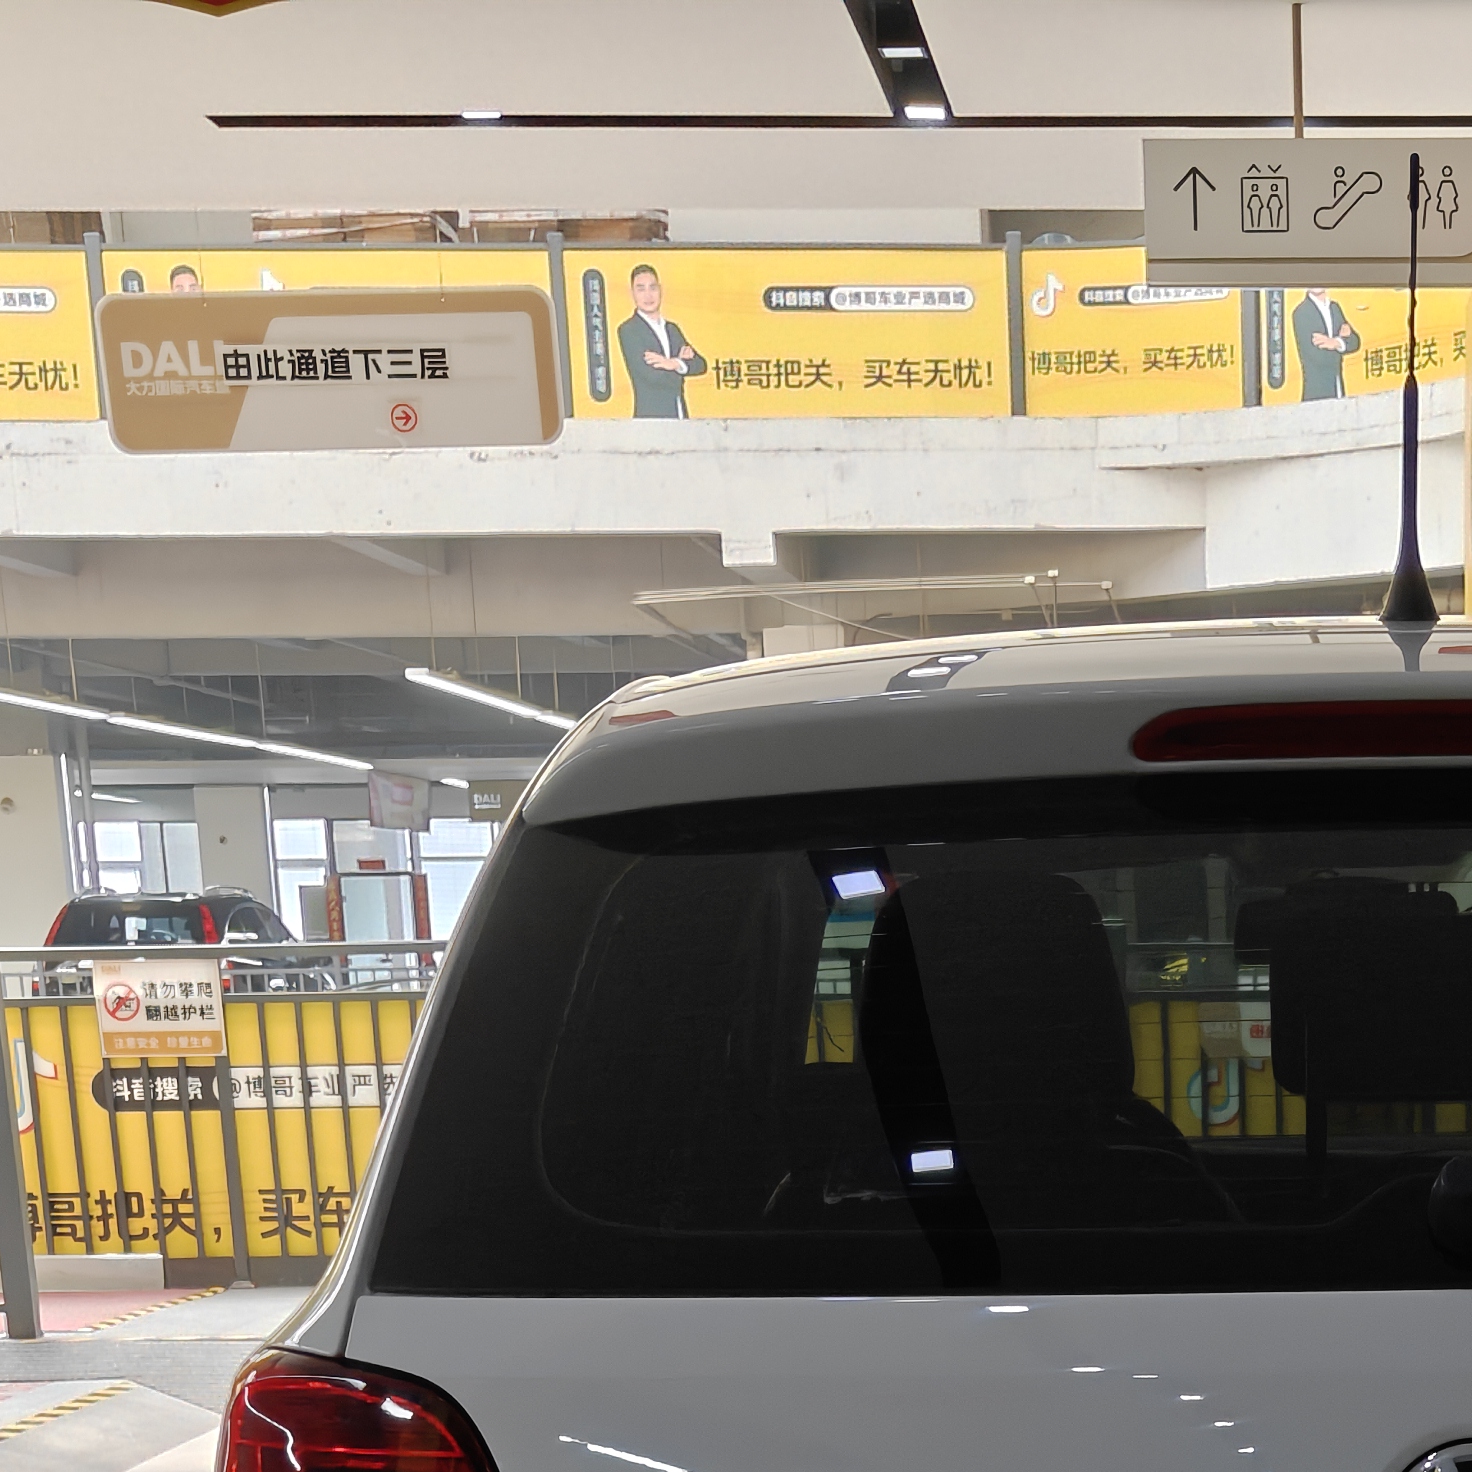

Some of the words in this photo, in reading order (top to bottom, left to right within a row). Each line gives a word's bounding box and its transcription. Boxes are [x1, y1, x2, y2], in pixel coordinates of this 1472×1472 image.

[223, 347, 450, 382] 由此通道下三层
[141, 981, 214, 999] 请勿攀爬
[144, 1004, 216, 1021] 翻越护栏
